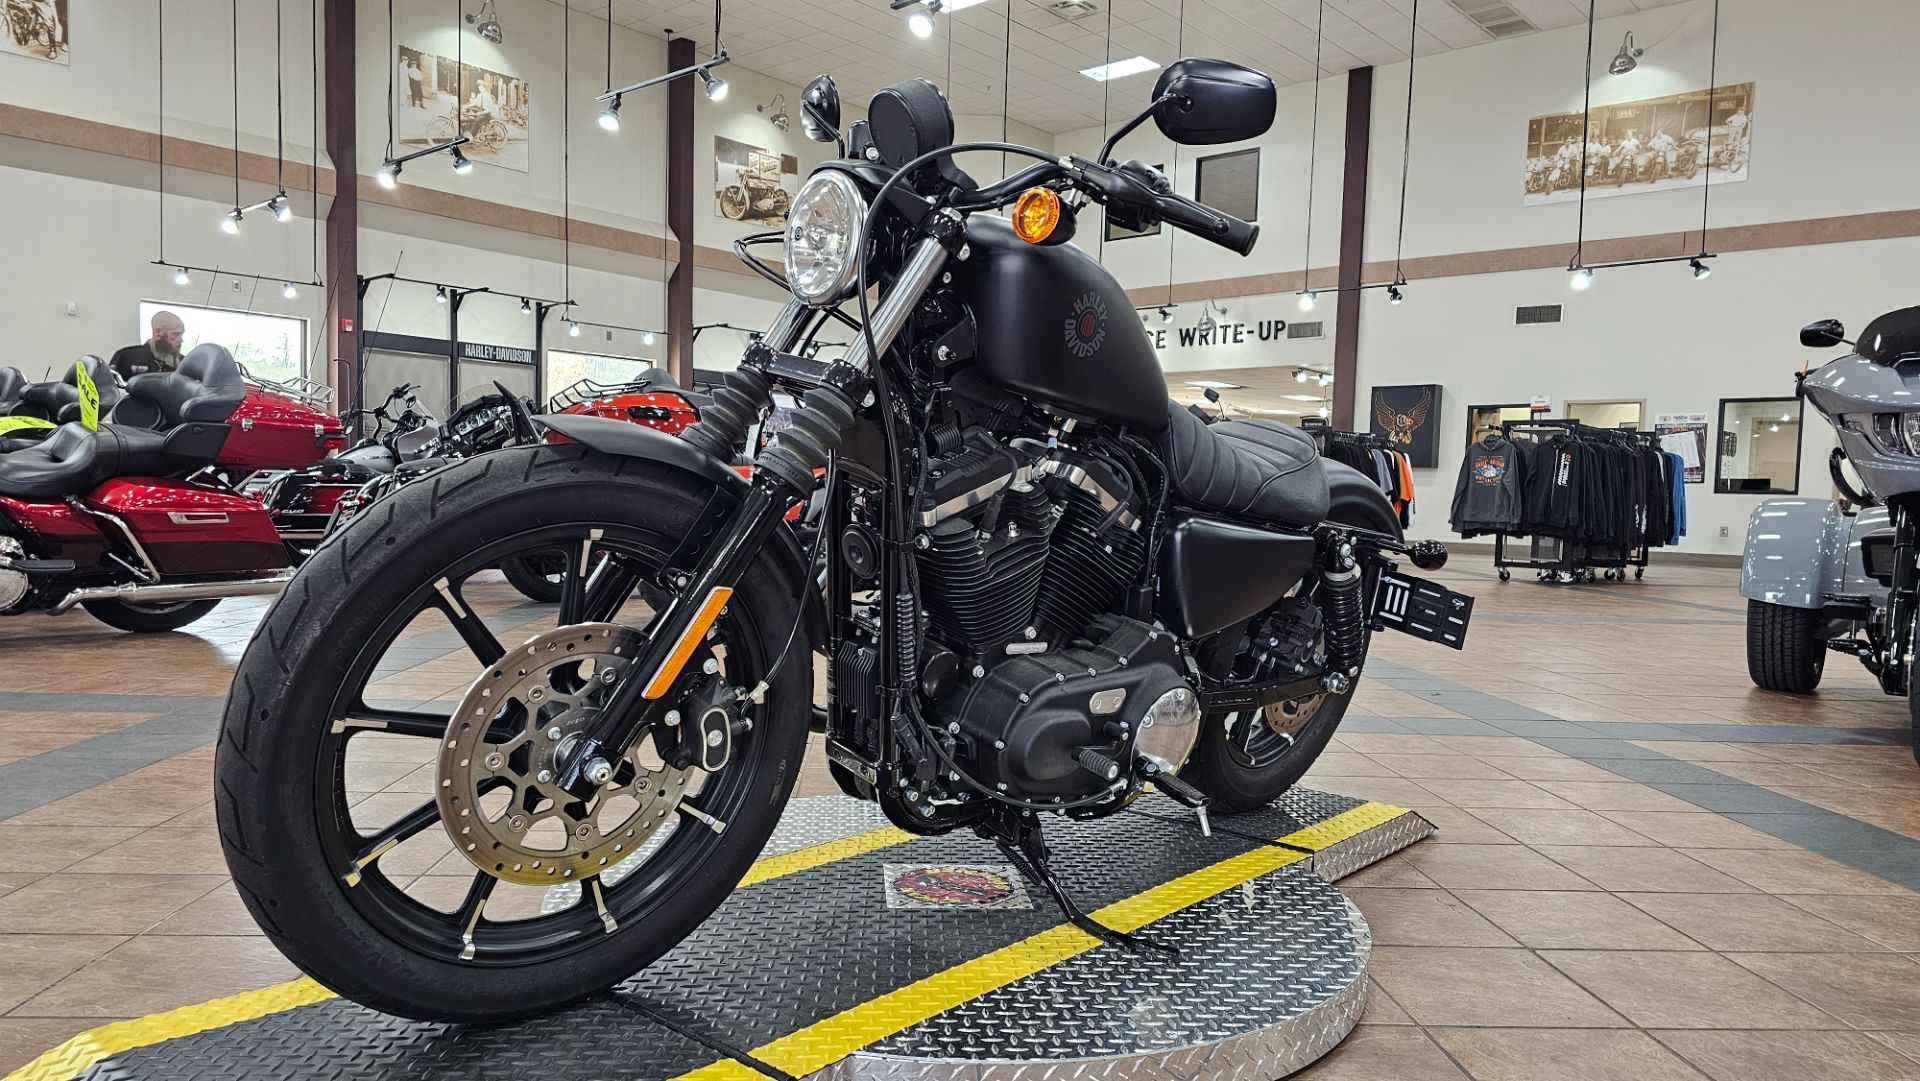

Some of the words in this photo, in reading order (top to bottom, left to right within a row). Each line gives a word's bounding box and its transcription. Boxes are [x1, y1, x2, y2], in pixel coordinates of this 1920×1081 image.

[1073, 292, 1107, 320] HARLEY
[1064, 319, 1106, 357] DAVIDSON
[1179, 320, 1286, 347] WRITE-UP
[465, 343, 532, 364] HARLEY-DAVIDSON
